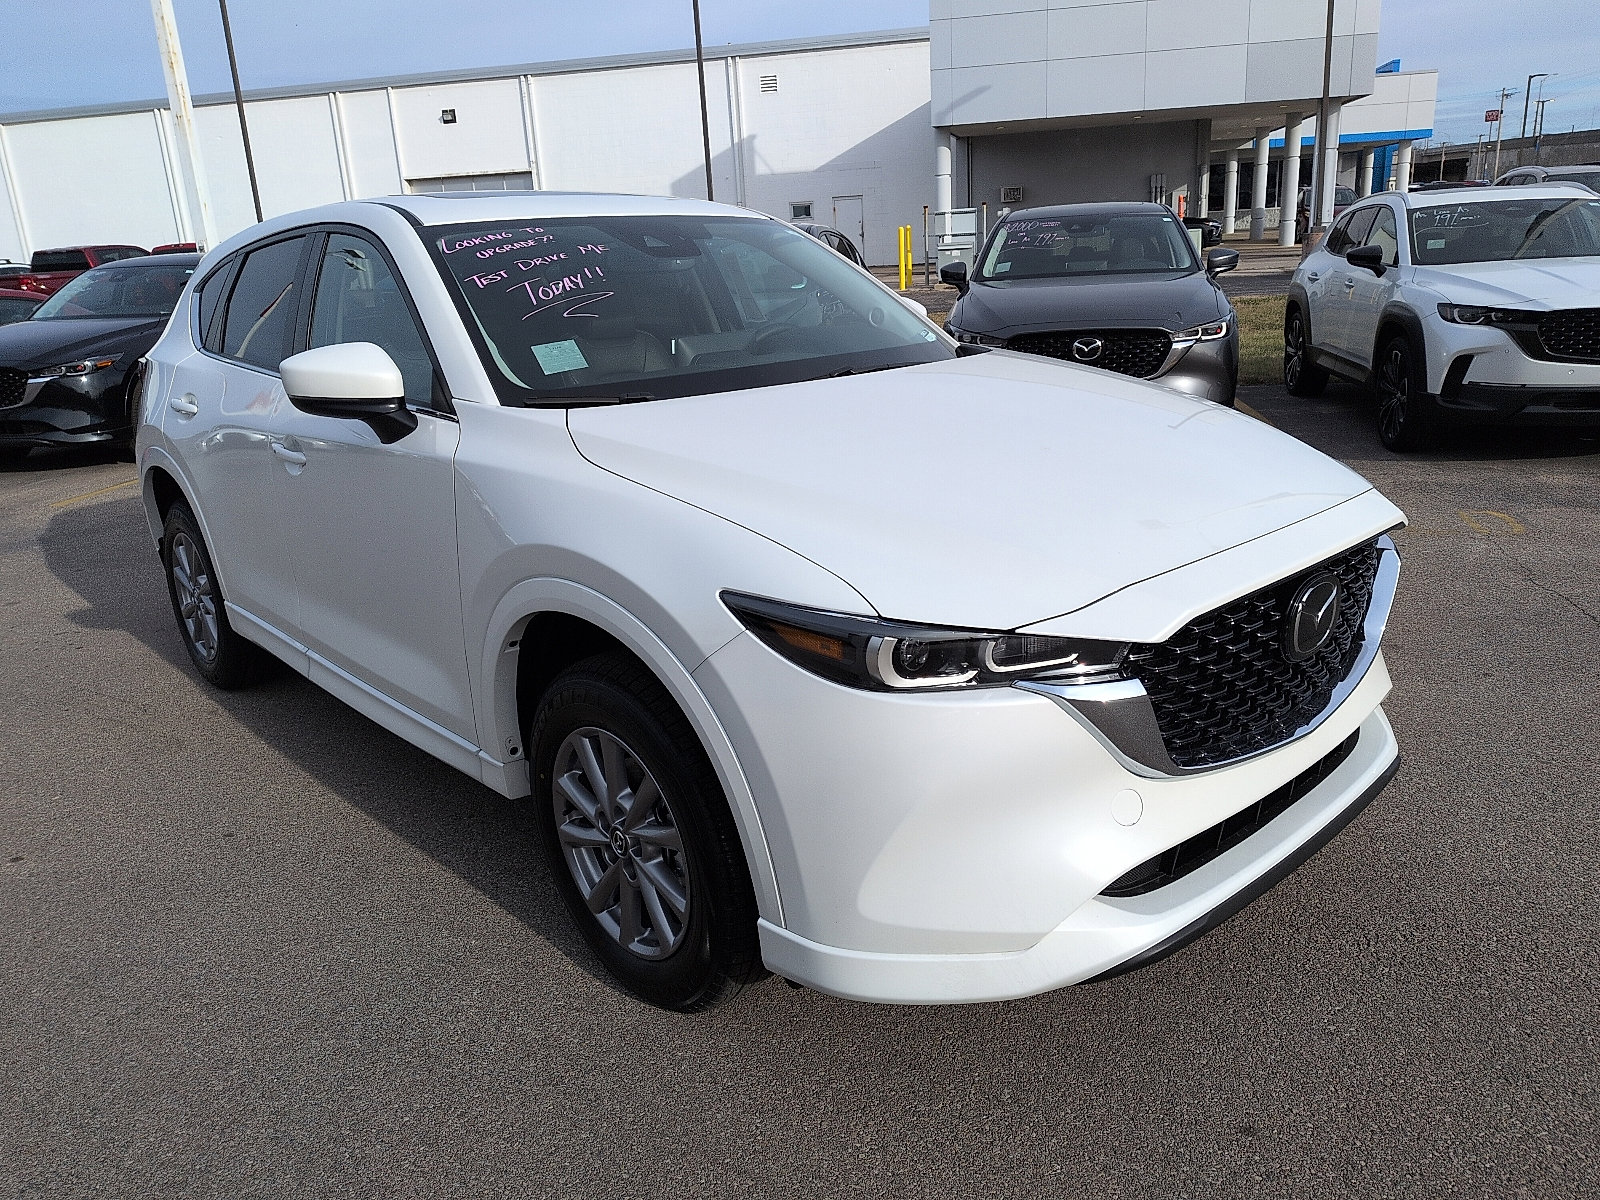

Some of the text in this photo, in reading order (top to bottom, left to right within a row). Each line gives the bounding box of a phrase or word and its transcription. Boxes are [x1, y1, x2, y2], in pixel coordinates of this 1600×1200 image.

[441, 226, 545, 254] LOOKING TO
[463, 243, 611, 289] TEST DRIVE ME
